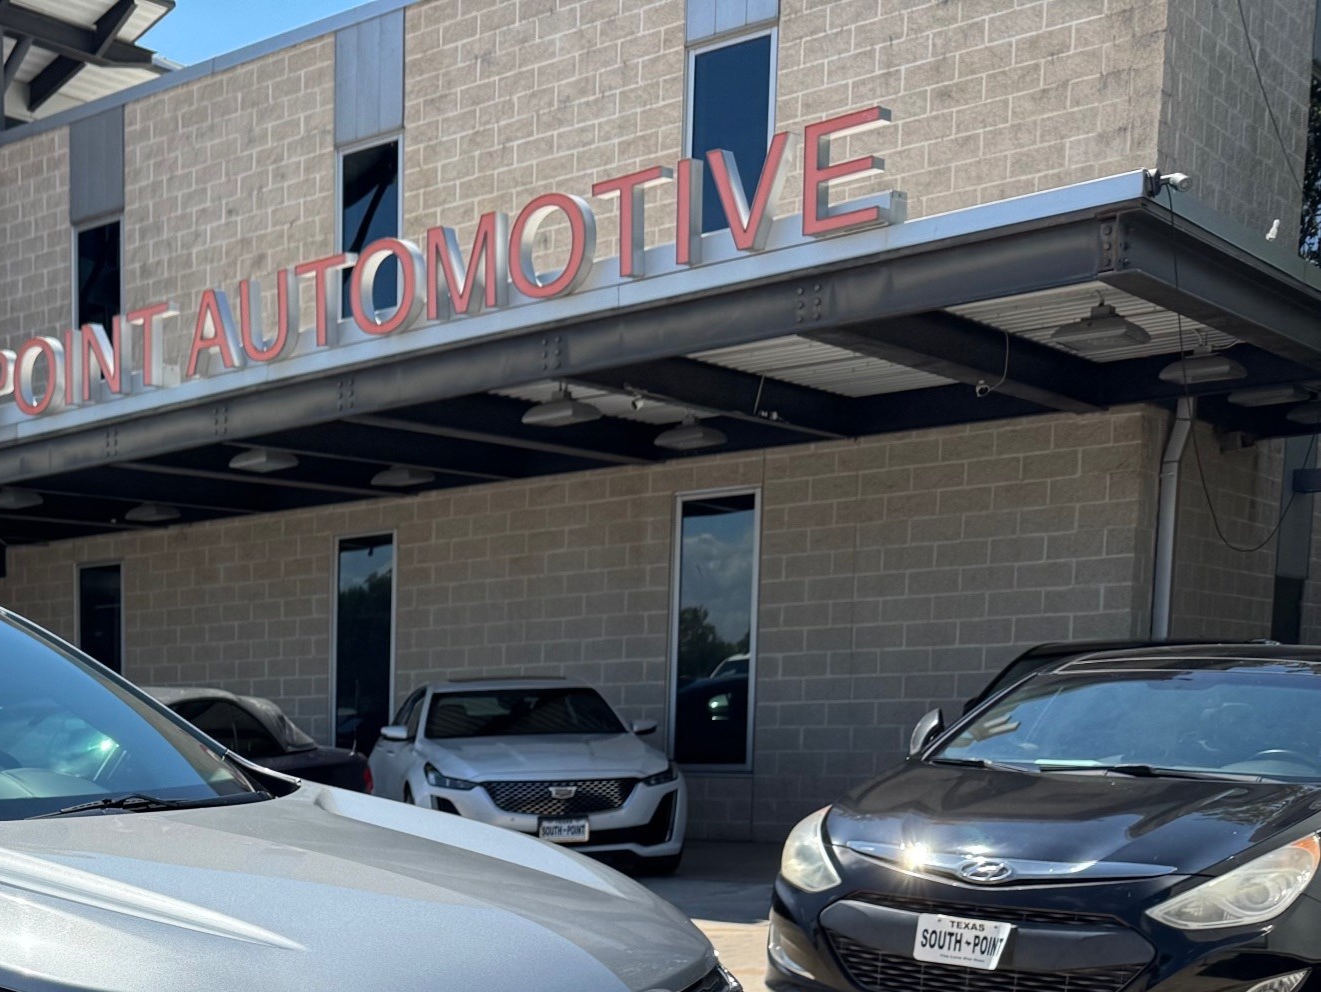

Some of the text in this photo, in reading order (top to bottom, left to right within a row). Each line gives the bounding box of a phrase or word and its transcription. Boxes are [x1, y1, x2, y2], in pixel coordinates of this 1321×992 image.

[185, 106, 892, 379] AUTOMOTIVE
[950, 920, 985, 932] TEXAS
[921, 929, 1004, 957] SOUTH POINT
